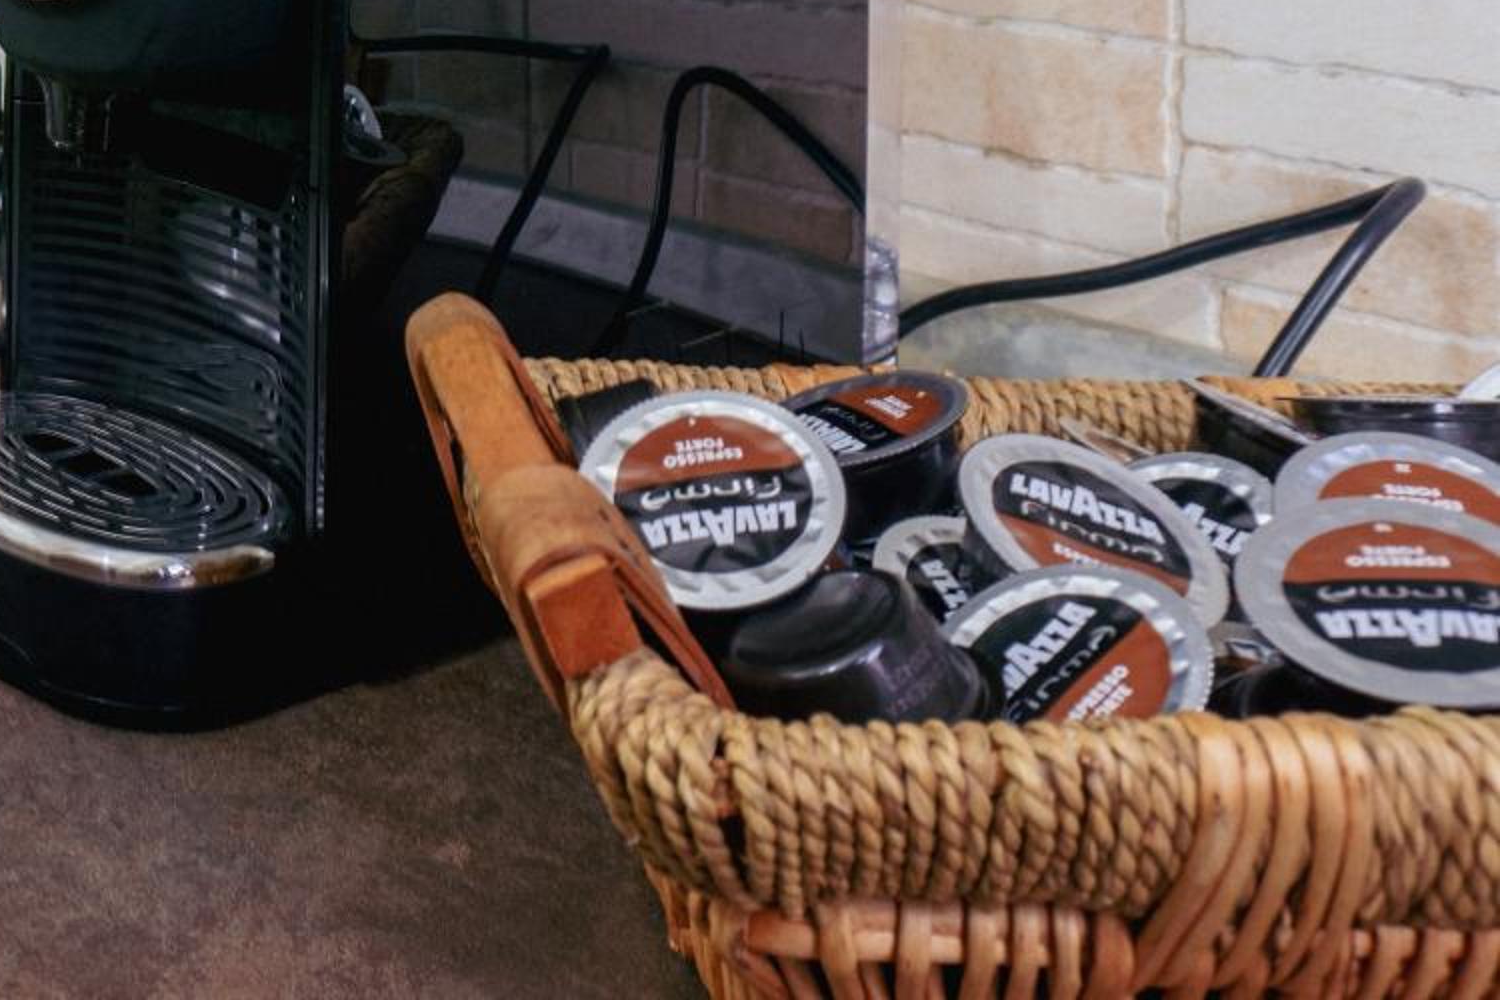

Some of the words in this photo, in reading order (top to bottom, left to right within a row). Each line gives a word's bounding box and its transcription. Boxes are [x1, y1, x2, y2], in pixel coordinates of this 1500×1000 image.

[662, 445, 744, 470] ESPRESSO
[675, 435, 725, 452] FORTE
[640, 500, 798, 548] LAVAZZA
[1009, 473, 1166, 545] LAVAZZA
[1067, 664, 1129, 720] SPRESSO
[1091, 683, 1133, 719] ORTE
